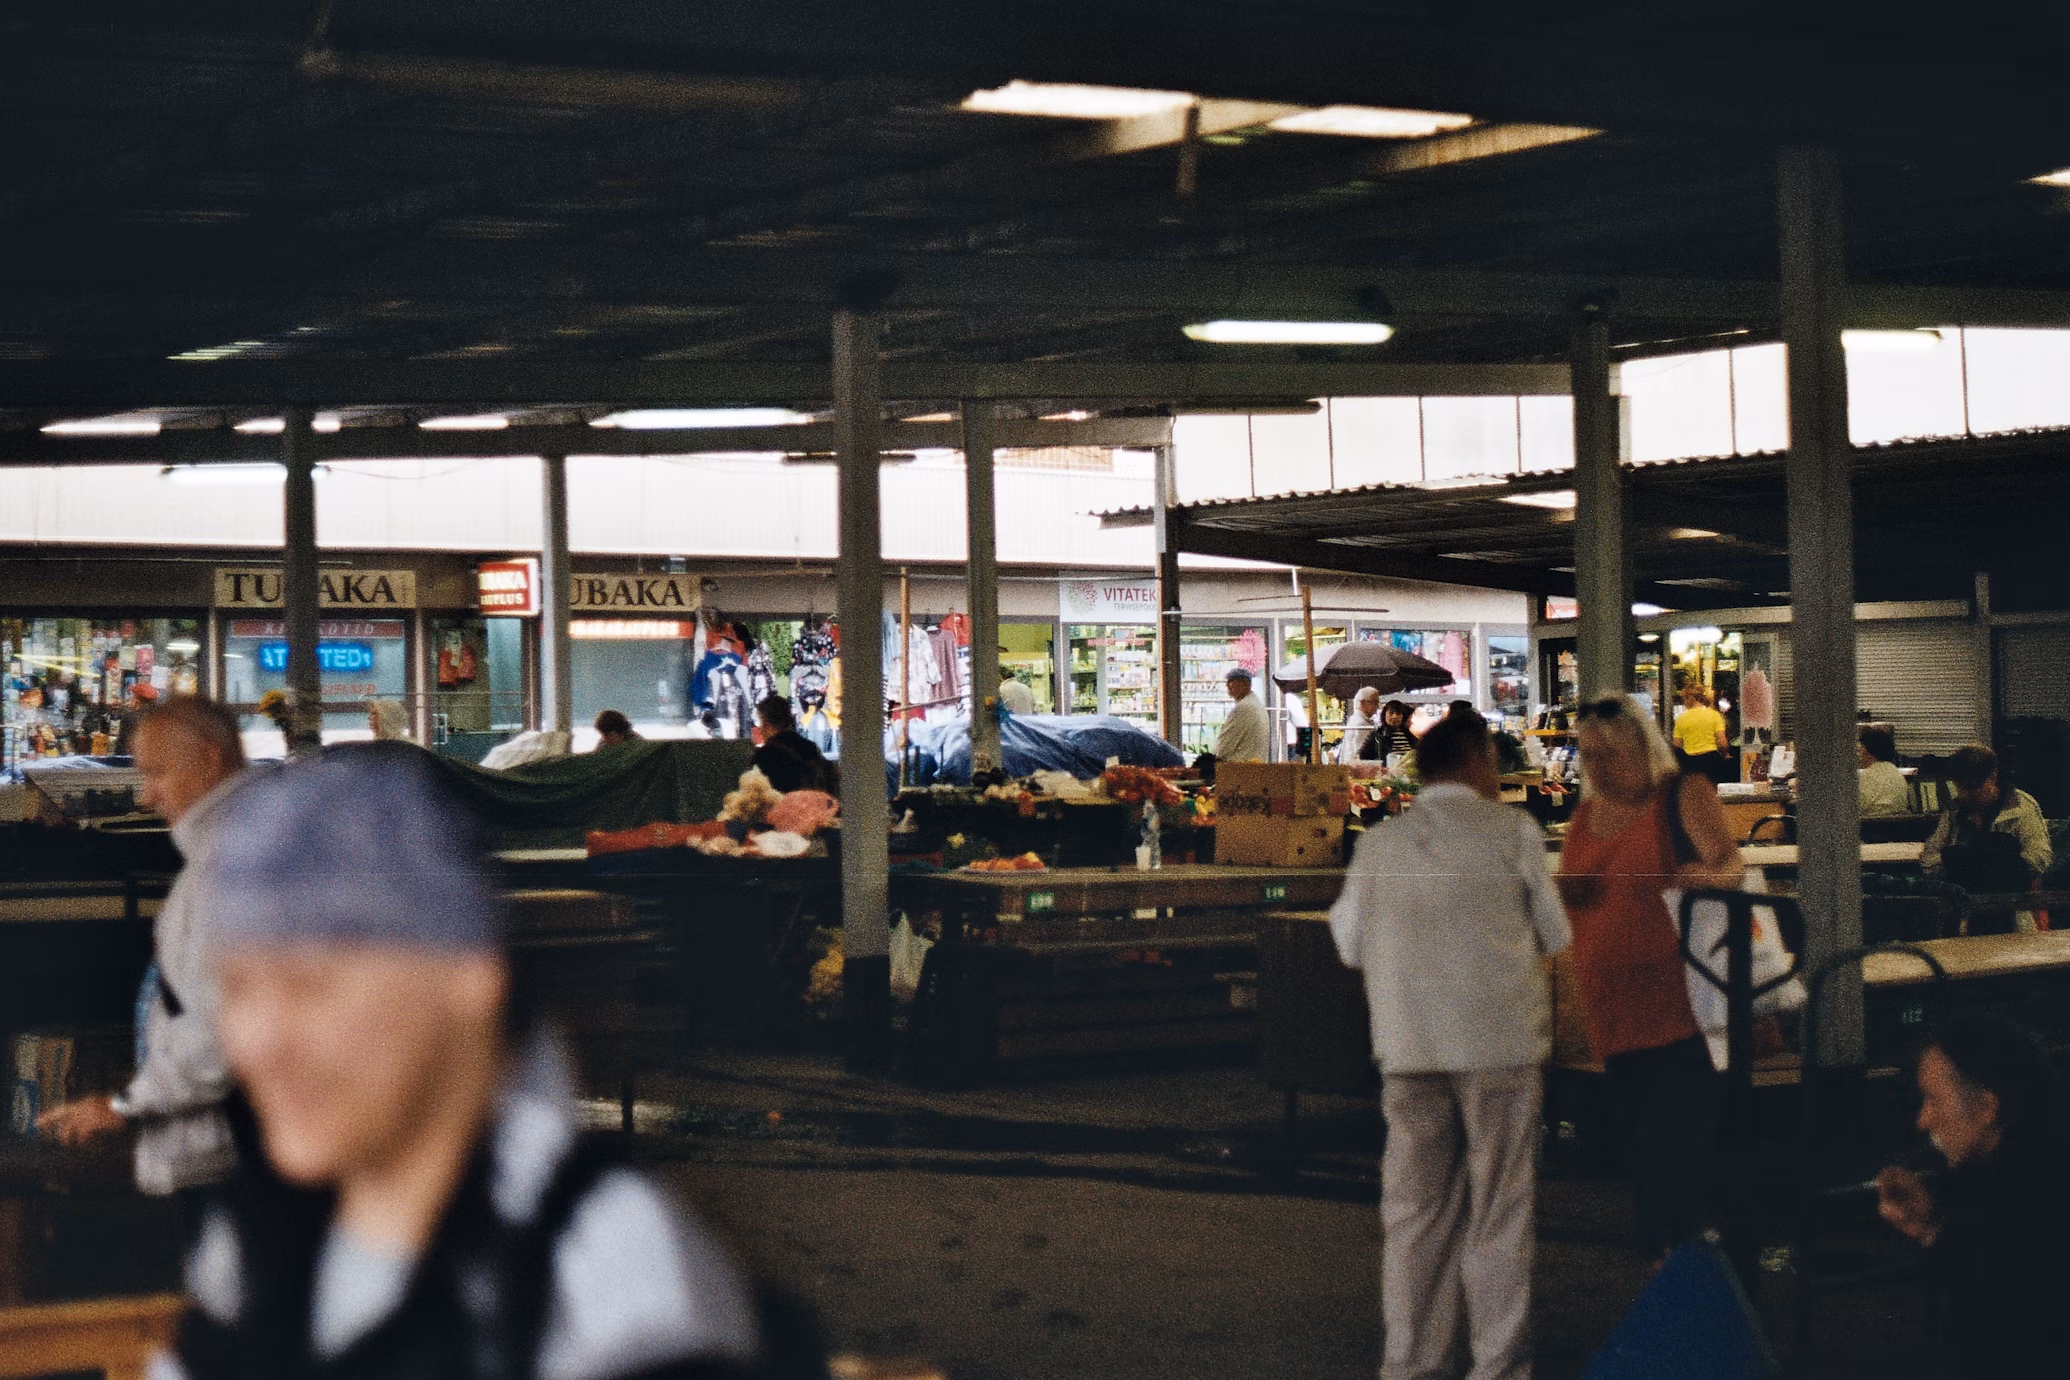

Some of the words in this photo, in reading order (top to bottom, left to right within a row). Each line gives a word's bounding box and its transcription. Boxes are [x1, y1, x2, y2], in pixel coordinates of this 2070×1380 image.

[224, 573, 398, 604] TUAKA
[570, 578, 685, 606] BAKA
[1103, 587, 1157, 602] VITATEK
[1113, 602, 1157, 612] TERVISEPOO
